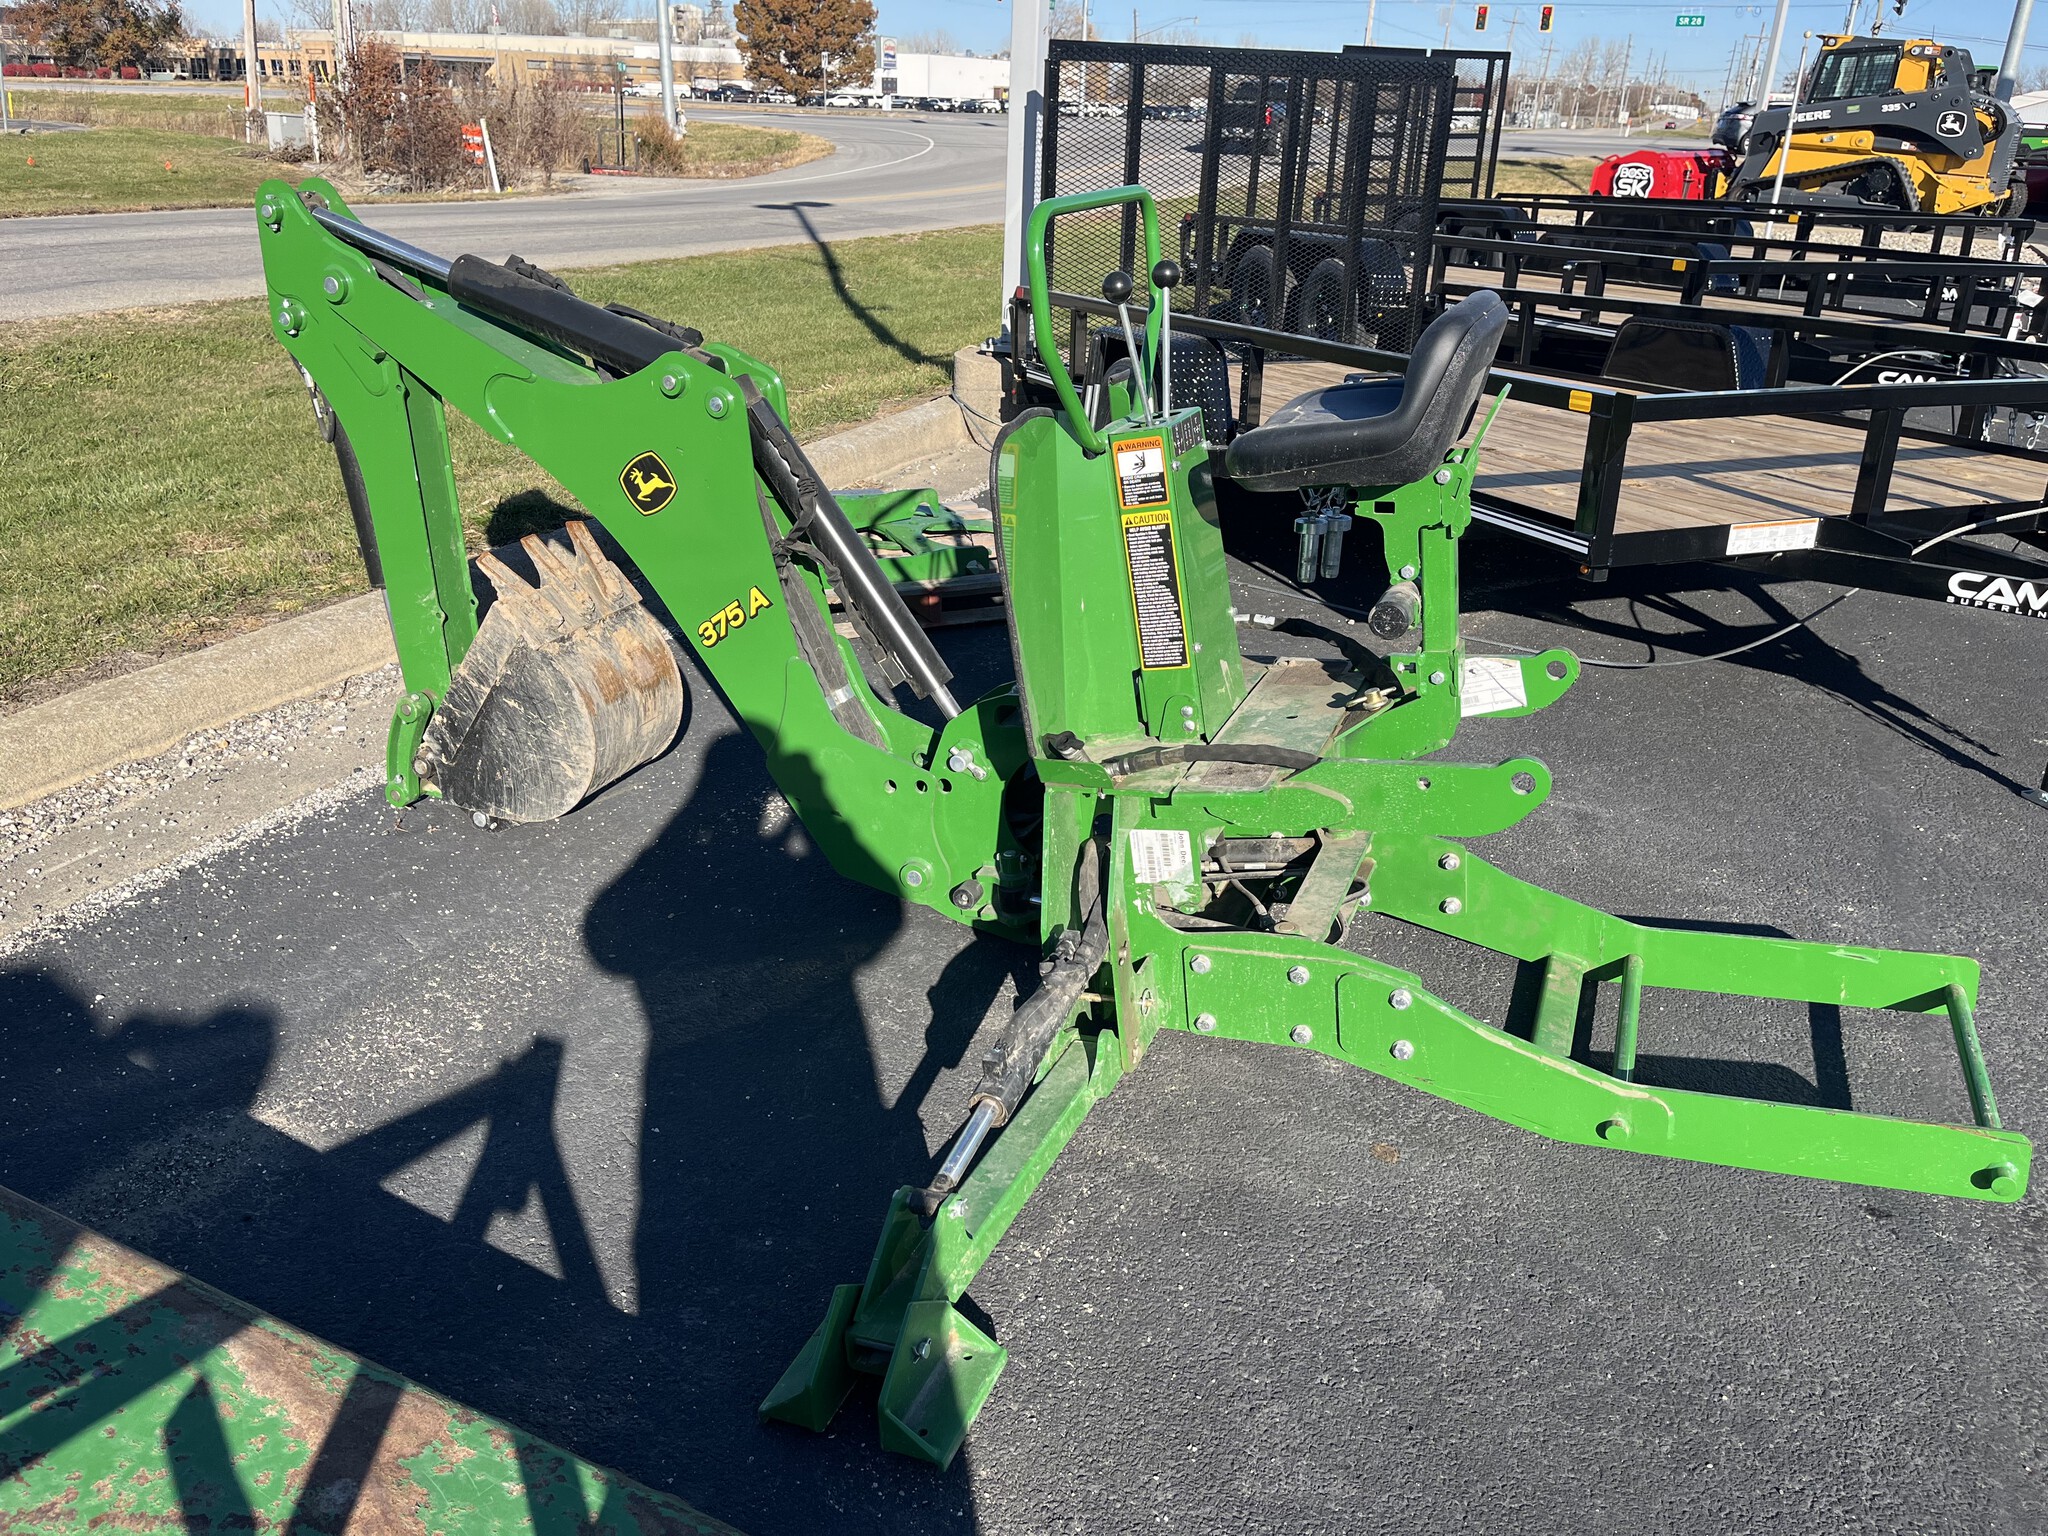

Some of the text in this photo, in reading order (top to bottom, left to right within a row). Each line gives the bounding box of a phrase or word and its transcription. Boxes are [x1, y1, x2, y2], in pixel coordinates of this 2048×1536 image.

[1679, 17, 1689, 25] SR
[1620, 167, 1650, 180] BOSS
[1616, 178, 1648, 197] SK
[1125, 440, 1160, 450] WARNING
[1133, 513, 1169, 525] CAUTION
[1948, 571, 2048, 611] CAM
[698, 585, 773, 648] 375 A
